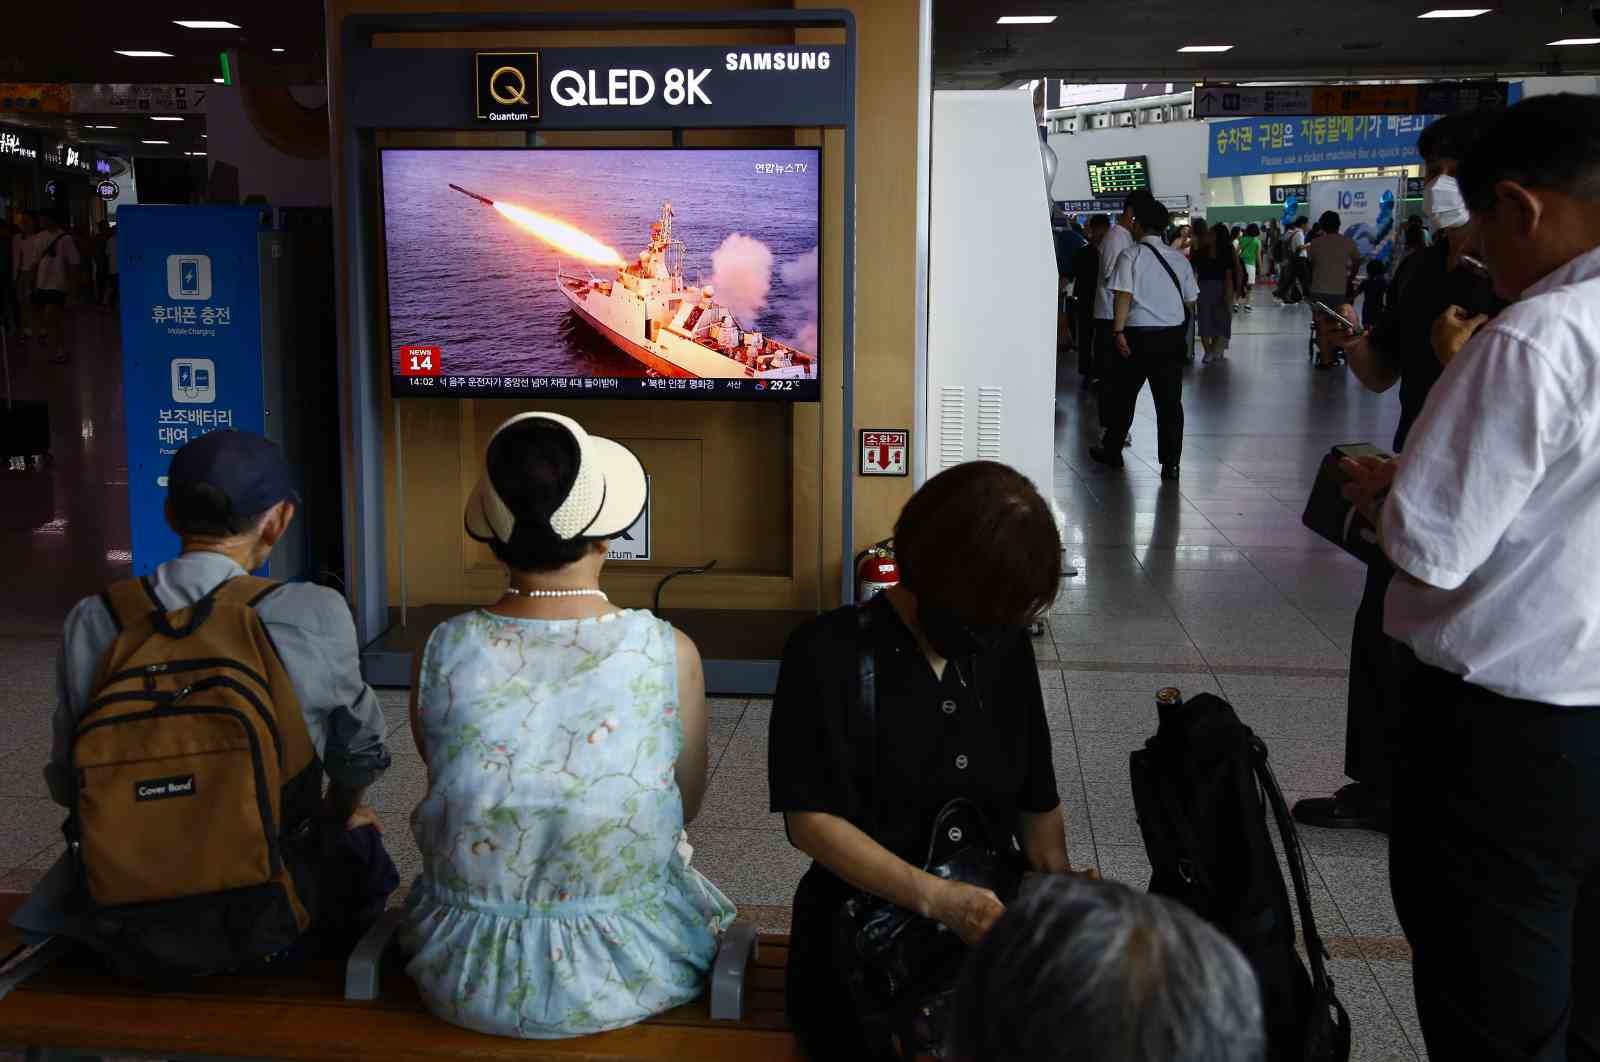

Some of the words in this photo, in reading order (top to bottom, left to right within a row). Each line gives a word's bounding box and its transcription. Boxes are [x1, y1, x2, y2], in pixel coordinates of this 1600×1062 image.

[725, 52, 831, 71] SAMSUNG
[489, 66, 529, 105] Q
[550, 68, 656, 107] QLED
[663, 68, 713, 106] 8K
[488, 111, 528, 122] Quantum
[1216, 126, 1253, 155] 승차권
[1258, 123, 1294, 150] 구입은
[1300, 115, 1381, 145] 자동발매기가
[1303, 152, 1325, 163] ticket
[1326, 150, 1358, 162] machine
[151, 304, 198, 325] 휴대폰
[199, 305, 232, 325] 충전
[167, 327, 188, 336] Mobile
[188, 327, 216, 337] Charging
[410, 356, 433, 370] 14
[409, 377, 435, 387] 14:02
[449, 376, 466, 387] 음주
[468, 376, 501, 388] 운전자가
[503, 377, 529, 388] 중앙선
[531, 377, 548, 389] 넘어
[569, 377, 582, 389] 4대
[158, 408, 232, 427] 보조배터리
[158, 427, 189, 445] 대여
[866, 434, 903, 443] 소화기
[138, 786, 166, 796] Cover
